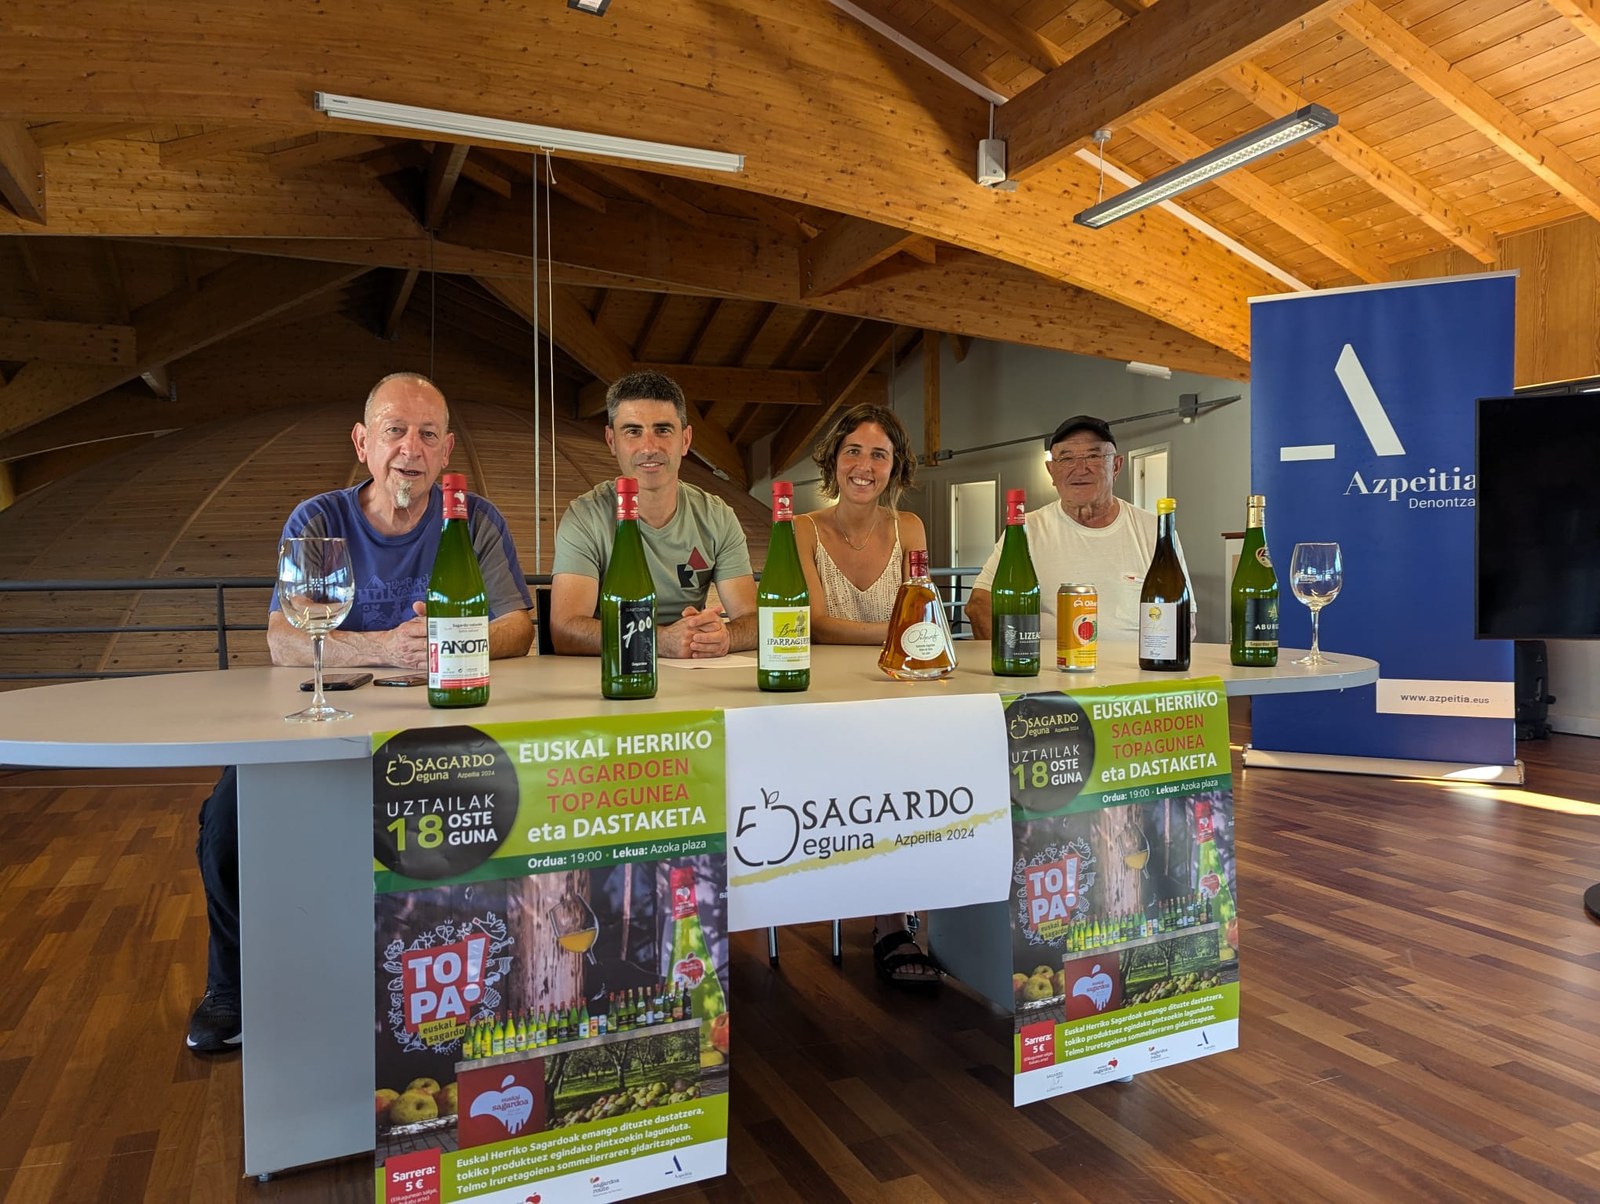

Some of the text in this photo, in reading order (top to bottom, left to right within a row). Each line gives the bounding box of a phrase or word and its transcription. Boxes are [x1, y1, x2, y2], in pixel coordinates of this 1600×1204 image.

[1343, 467, 1476, 502] Azpeitia
[1409, 497, 1476, 509] Denontza
[440, 638, 488, 654] AÑOTA
[1093, 691, 1218, 720] EUSKAL HERRIKO
[1400, 694, 1490, 704] www.azpeitia.eus
[1028, 713, 1078, 728] SAGARDO
[1029, 727, 1050, 737] eguna
[1111, 713, 1204, 739] SAGARDOEN
[519, 730, 712, 763] EUSKAL HERRIKO
[1011, 744, 1080, 764] UZTAILAK
[1113, 734, 1205, 759] TOPAGUNEA
[416, 753, 495, 772] SAGARDO
[546, 757, 689, 788] SAGARDOEN
[1050, 758, 1079, 772] OSTE
[1101, 752, 1217, 783] eta DASTAKETA
[416, 771, 449, 783] eguna
[1012, 761, 1049, 790] 18
[1051, 771, 1083, 786] GUNA
[547, 783, 689, 814] TOPAGUNEA
[1102, 779, 1218, 804] Ordua: 19:00 Lekua: Azoka plaza
[387, 793, 495, 817] UZTAILAK
[802, 786, 974, 830] SAGARDO
[448, 811, 493, 828] OSTE
[527, 806, 707, 843] eta DASTAKETA
[386, 814, 444, 851] 18
[448, 828, 498, 846] GUNA
[803, 828, 975, 859] eguna Azpeitia 2024
[527, 839, 707, 869] Ordua: 19:00 Lekua: Azoka plaza
[423, 1020, 452, 1034] euskal
[1064, 1025, 1085, 1036] Euskal
[1086, 1020, 1110, 1031] Herriko
[1111, 1011, 1142, 1024] Sagardoak
[1144, 1006, 1167, 1017] emango
[1064, 1036, 1085, 1047] tokiko
[1087, 1027, 1122, 1043] produktuez
[1124, 1020, 1151, 1033] egindako
[1033, 1043, 1045, 1054] 5 €
[1064, 1047, 1085, 1057] Telmo
[456, 1108, 704, 1168] Euskal Herriko Sagardoak emango dituzte dastatzera,
[456, 1123, 691, 1181] tokiko produktuez egindako pintxoekin lagunduta.
[456, 1135, 693, 1194] Telmo Iruretagoiena sommelierraren gidaritzapean.
[392, 1166, 436, 1182] Sarrera:
[405, 1179, 424, 1191] 5 €
